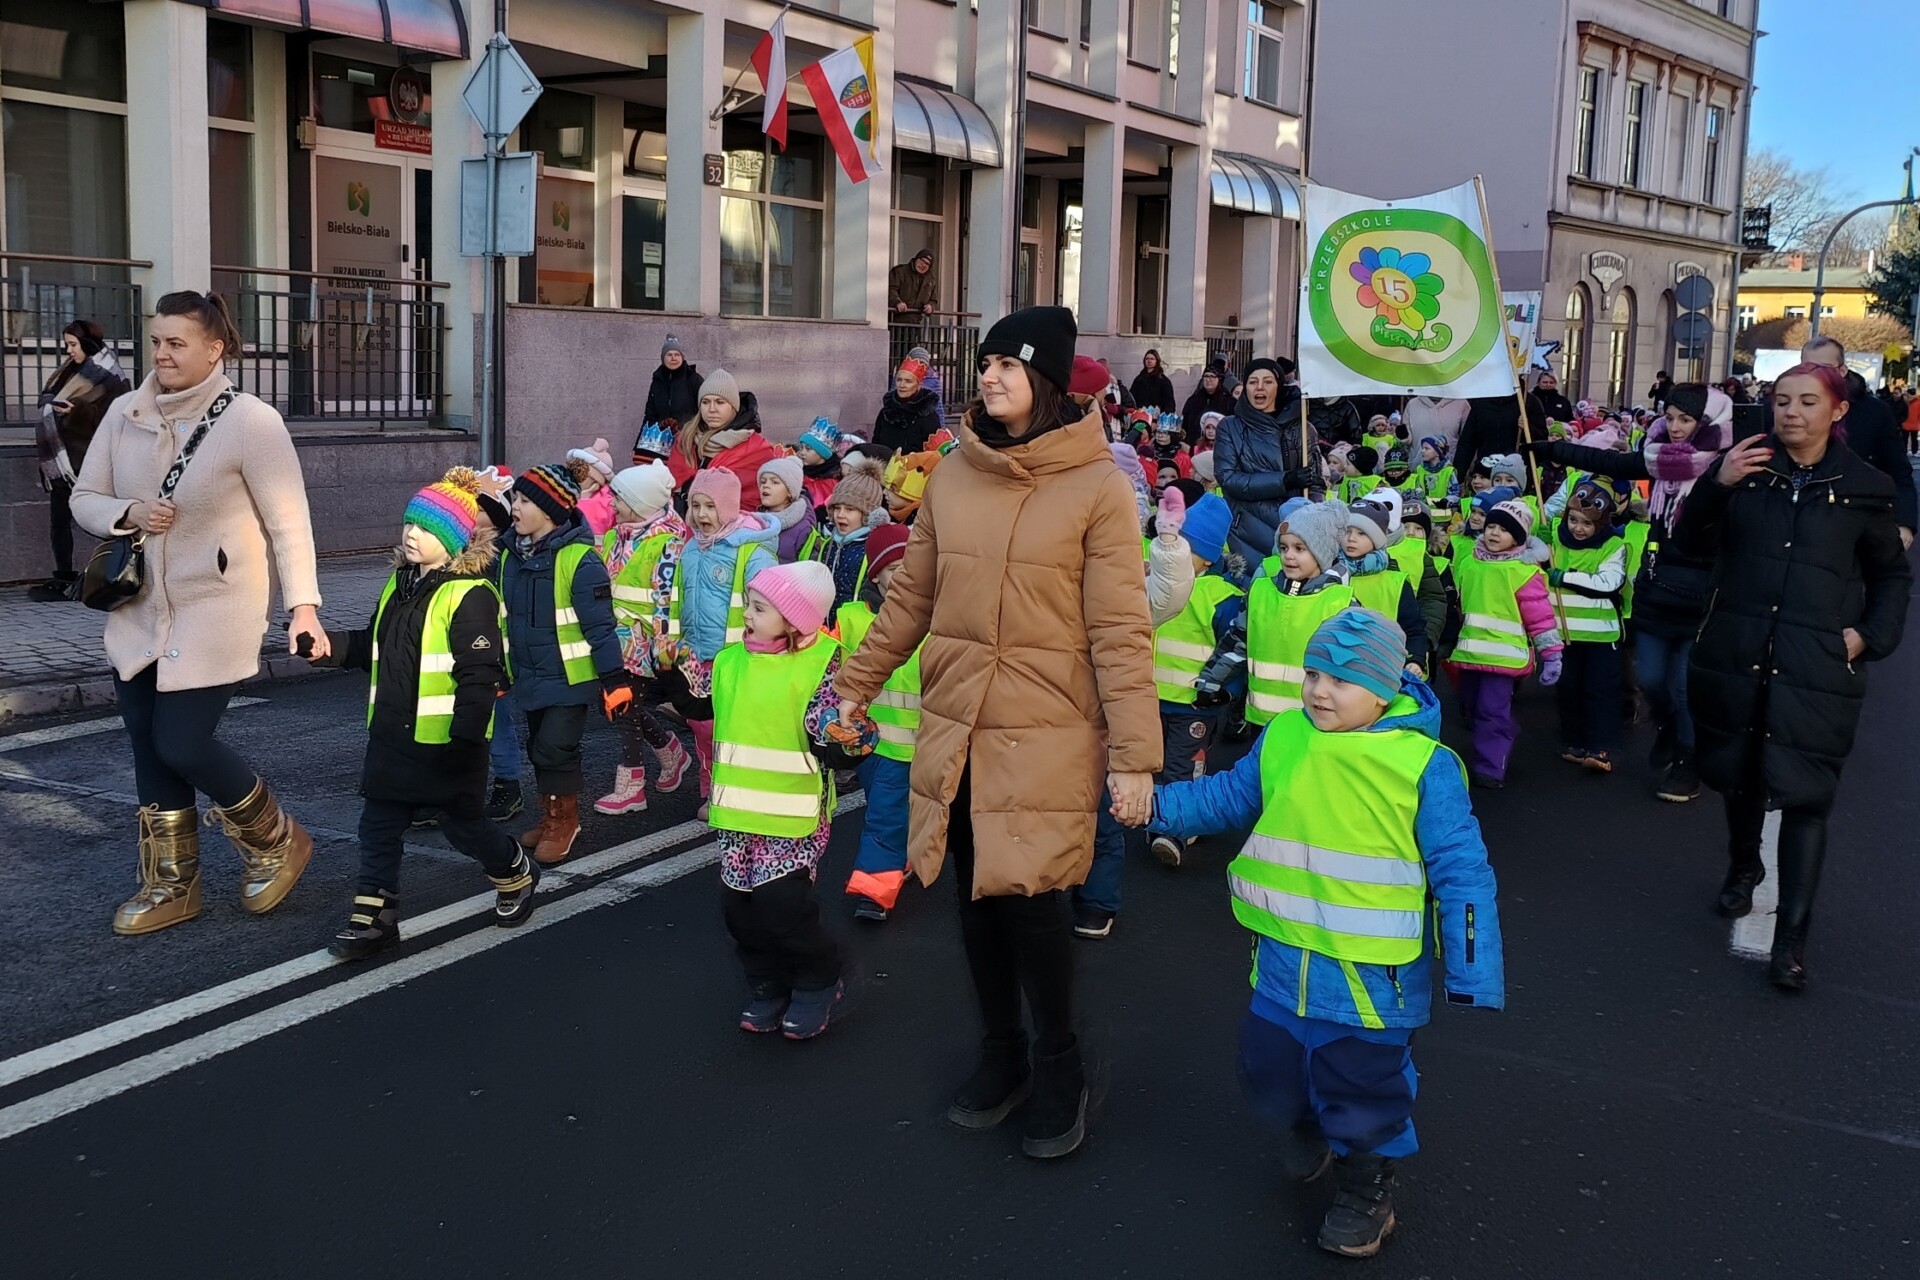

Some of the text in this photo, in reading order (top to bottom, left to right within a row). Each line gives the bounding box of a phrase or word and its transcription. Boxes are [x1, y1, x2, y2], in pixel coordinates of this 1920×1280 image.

[708, 166, 722, 183] 32
[327, 221, 390, 238] Bielsko-Biała
[1316, 215, 1392, 291] PRZEDSZKOLE
[358, 267, 386, 279] MIEJSKI
[1377, 276, 1410, 304] 15
